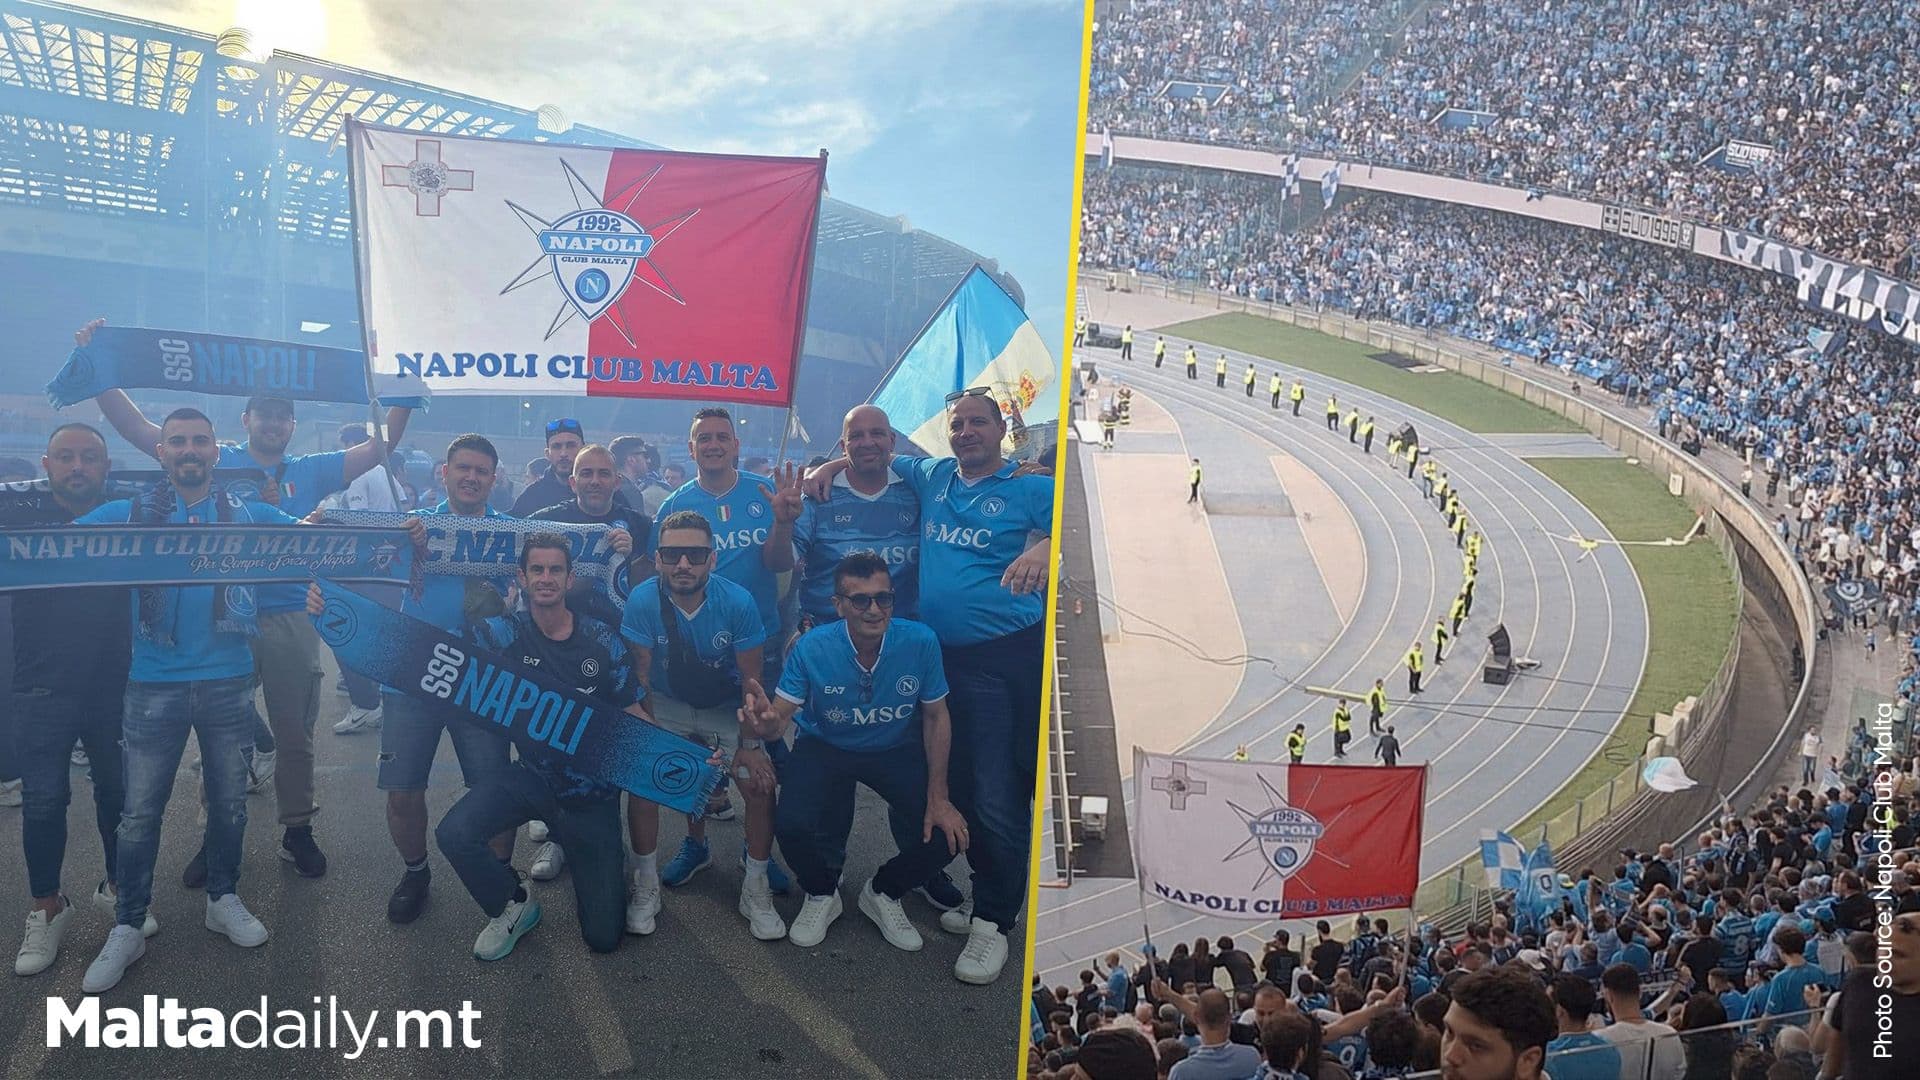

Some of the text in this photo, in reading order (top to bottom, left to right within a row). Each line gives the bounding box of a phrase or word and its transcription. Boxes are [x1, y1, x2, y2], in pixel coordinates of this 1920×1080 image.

[575, 214, 622, 232] 1992
[548, 236, 645, 253] NAPOLI
[591, 257, 628, 265] MALTA
[584, 278, 600, 294] N
[158, 338, 319, 392] SSC NAPOLI
[396, 352, 780, 391] NAPOLI CLUB MALTA
[834, 514, 852, 523] EA7
[713, 528, 768, 551] MSC
[935, 524, 993, 550] MSC
[8, 534, 359, 561] NAPOLI CLUB MALTA
[190, 555, 216, 573] Per
[267, 554, 308, 572] Forza
[309, 552, 358, 571] Napoli
[523, 655, 541, 667] EA7
[420, 642, 598, 756] SSC NAPOLI
[823, 685, 846, 695] EA7
[851, 703, 914, 727] MSC
[1272, 809, 1302, 822] 1992
[1255, 825, 1318, 836] NAPOLI
[1154, 882, 1247, 913] NAPOLI
[1253, 898, 1319, 913] CLUB
